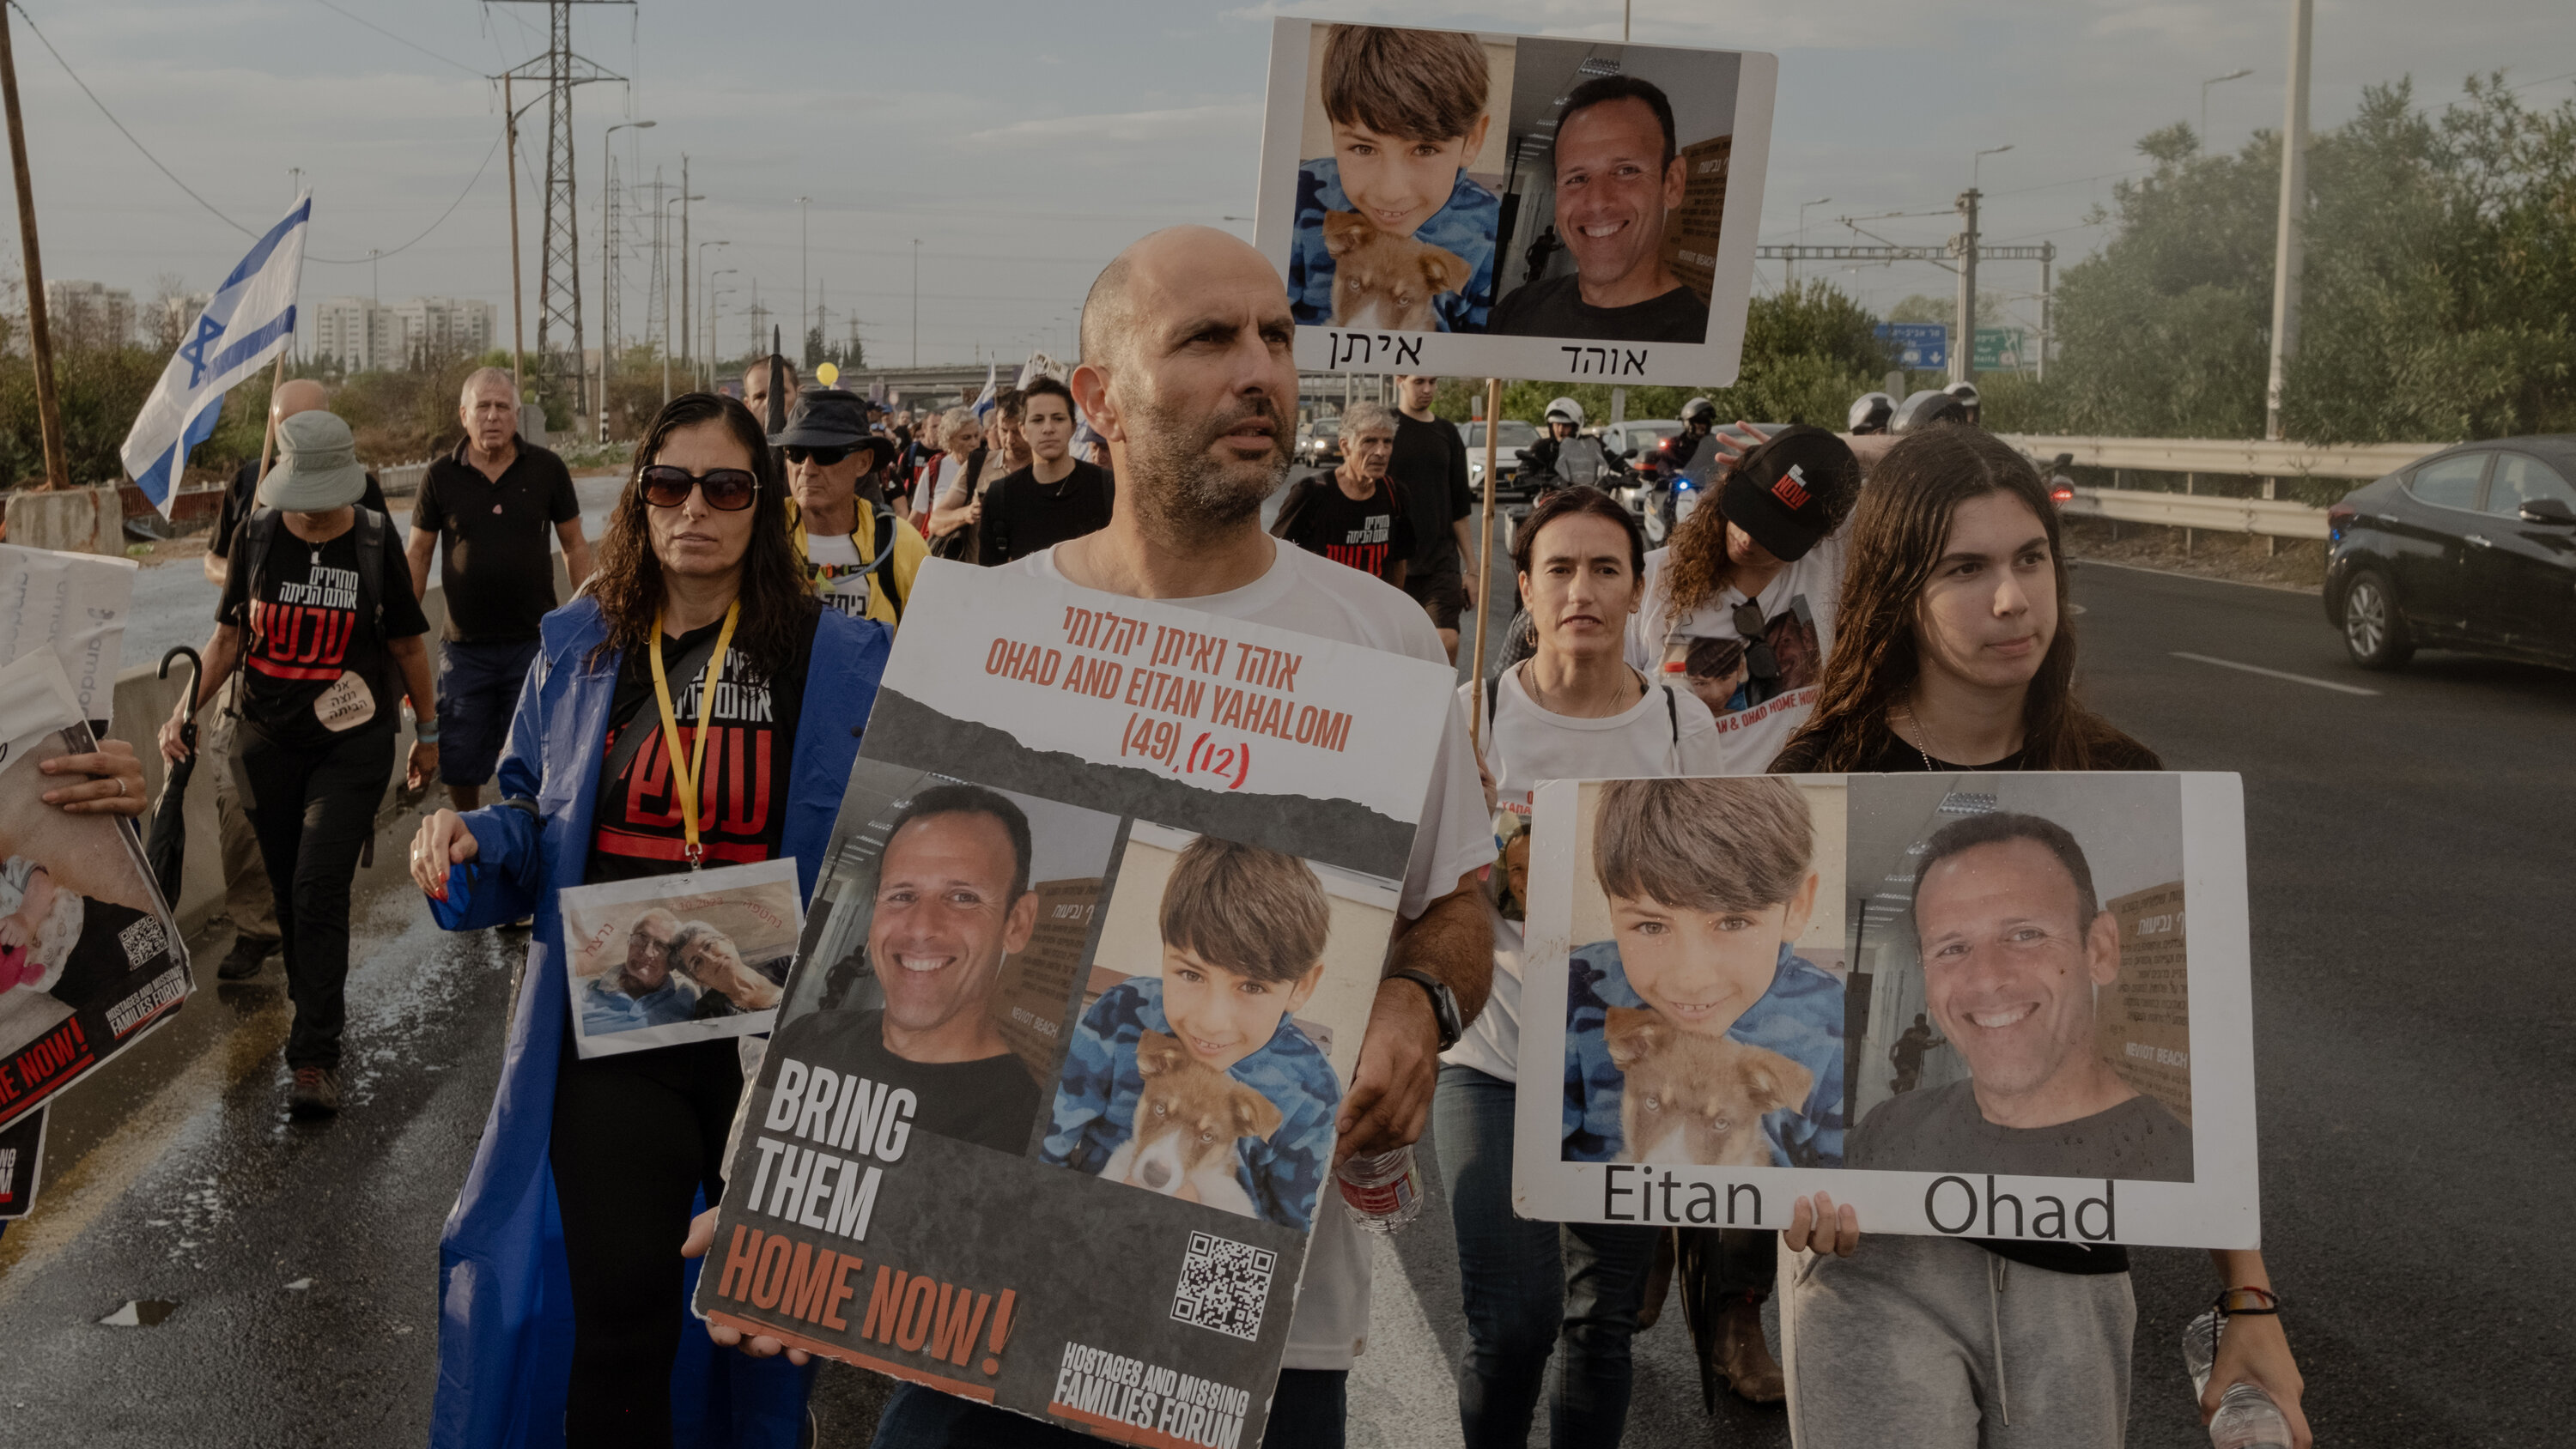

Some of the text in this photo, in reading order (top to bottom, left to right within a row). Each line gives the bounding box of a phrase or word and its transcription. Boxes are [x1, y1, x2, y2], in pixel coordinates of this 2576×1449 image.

[1330, 331, 1423, 370] איתן
[1561, 345, 1647, 377] אוהד
[1774, 473, 1812, 508] NOW
[278, 581, 357, 610] אותם הביתה
[309, 566, 359, 591] מחזירים
[1062, 606, 1303, 693] אוהד ואיתן יהלומי
[985, 638, 1352, 753] OHAD AND EITAN YAHALOMI
[1741, 706, 1767, 727] OHAD
[1769, 694, 1796, 714] HOME
[1186, 732, 1249, 789] (12)
[1051, 904, 1084, 919] נביעות
[2136, 913, 2172, 936] נביעות
[584, 923, 616, 958] נרצח
[105, 965, 184, 1022] HOSTAGES AND MISSING
[108, 999, 153, 1037] FAMILIES
[1012, 1006, 1059, 1039] NEVIOT BEACH
[16, 1016, 88, 1088] NOW!
[2125, 1041, 2188, 1069] NEVIOT BEACH
[764, 1058, 917, 1162] BRING
[747, 1137, 883, 1240] THEM
[1603, 1165, 1763, 1228] Eitan
[1924, 1175, 2117, 1243] Ohad
[718, 1224, 1016, 1375] HOME NOW!
[1061, 1341, 1249, 1416] HOSTAGES AND MISSING
[1054, 1368, 1243, 1449] FAMILIES FORUM
